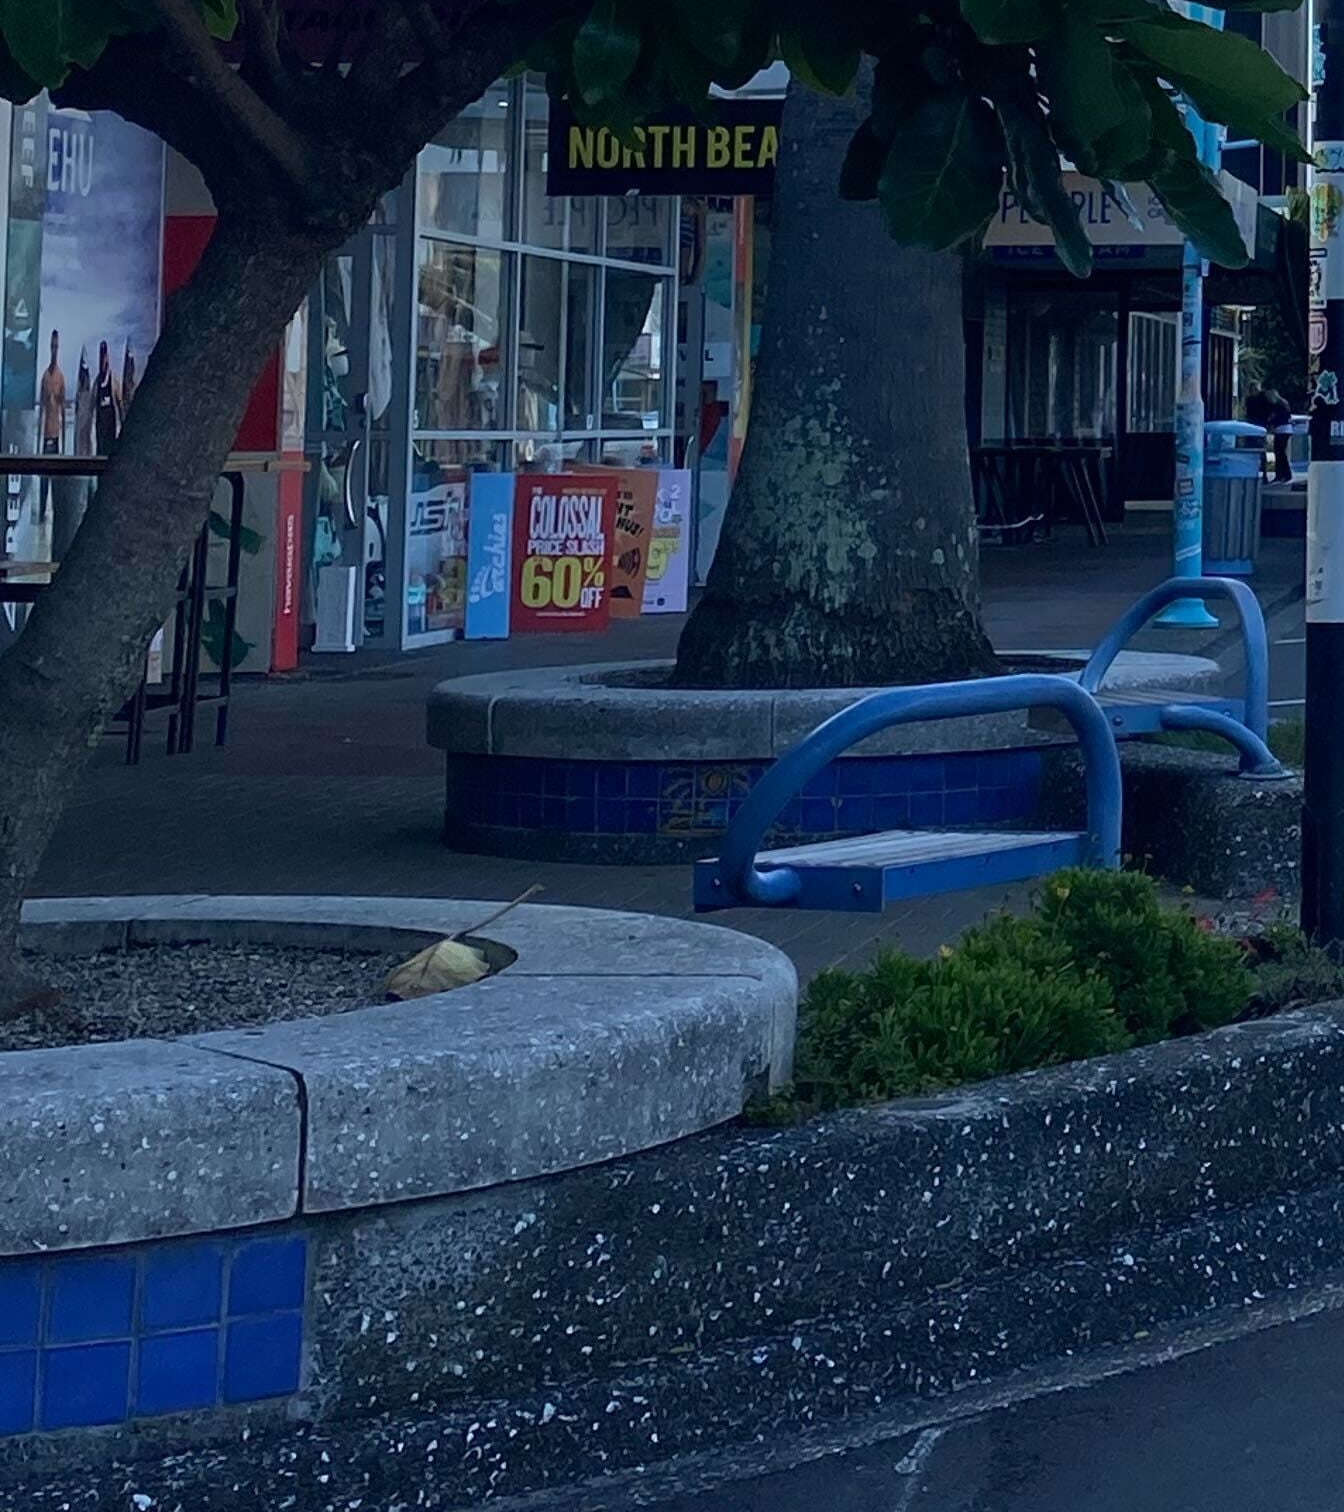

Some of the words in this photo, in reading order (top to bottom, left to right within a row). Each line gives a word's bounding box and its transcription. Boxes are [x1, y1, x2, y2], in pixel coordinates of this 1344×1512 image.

[567, 126, 696, 169] NORTH
[1002, 191, 1112, 224] PEPLE
[529, 495, 605, 539] COLOSSAL
[527, 539, 564, 556] PRICE
[564, 539, 605, 556] SLASH
[520, 556, 605, 609] 60%
[579, 587, 605, 609] OFF
